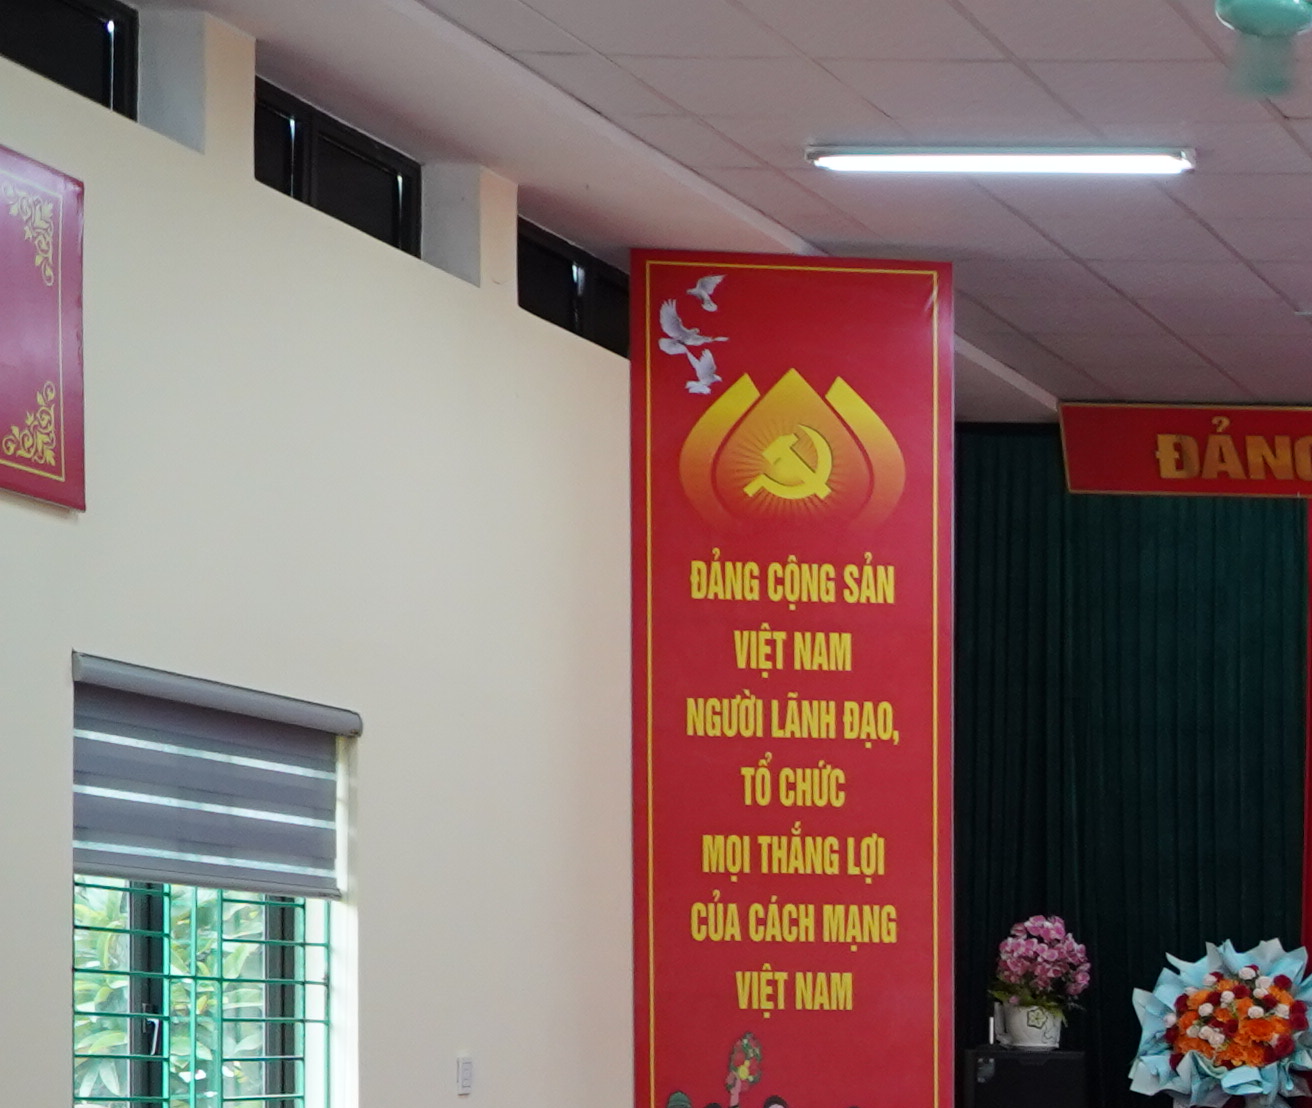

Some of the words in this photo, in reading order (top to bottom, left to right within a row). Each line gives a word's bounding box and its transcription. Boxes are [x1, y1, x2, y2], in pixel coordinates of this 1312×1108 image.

[690, 547, 760, 600] ĐẢNG
[767, 555, 836, 610] CỘNG
[843, 552, 895, 604] SẢN
[733, 622, 787, 678] VIỆT
[793, 631, 852, 671] NAM
[686, 689, 763, 738] NGƯỜI
[771, 692, 836, 739] LÃNH
[843, 700, 899, 749] ĐẠO,
[740, 752, 773, 806] TỔ
[779, 760, 846, 808] CHỨC
[702, 834, 751, 882] MỌI
[757, 821, 840, 875] THẮNG
[847, 833, 885, 884] LỢI
[690, 889, 742, 942] CỦA
[748, 895, 815, 943] CÁCH
[822, 904, 898, 951] MẠNG
[735, 963, 789, 1018] VIỆT
[795, 972, 853, 1011] NAM
